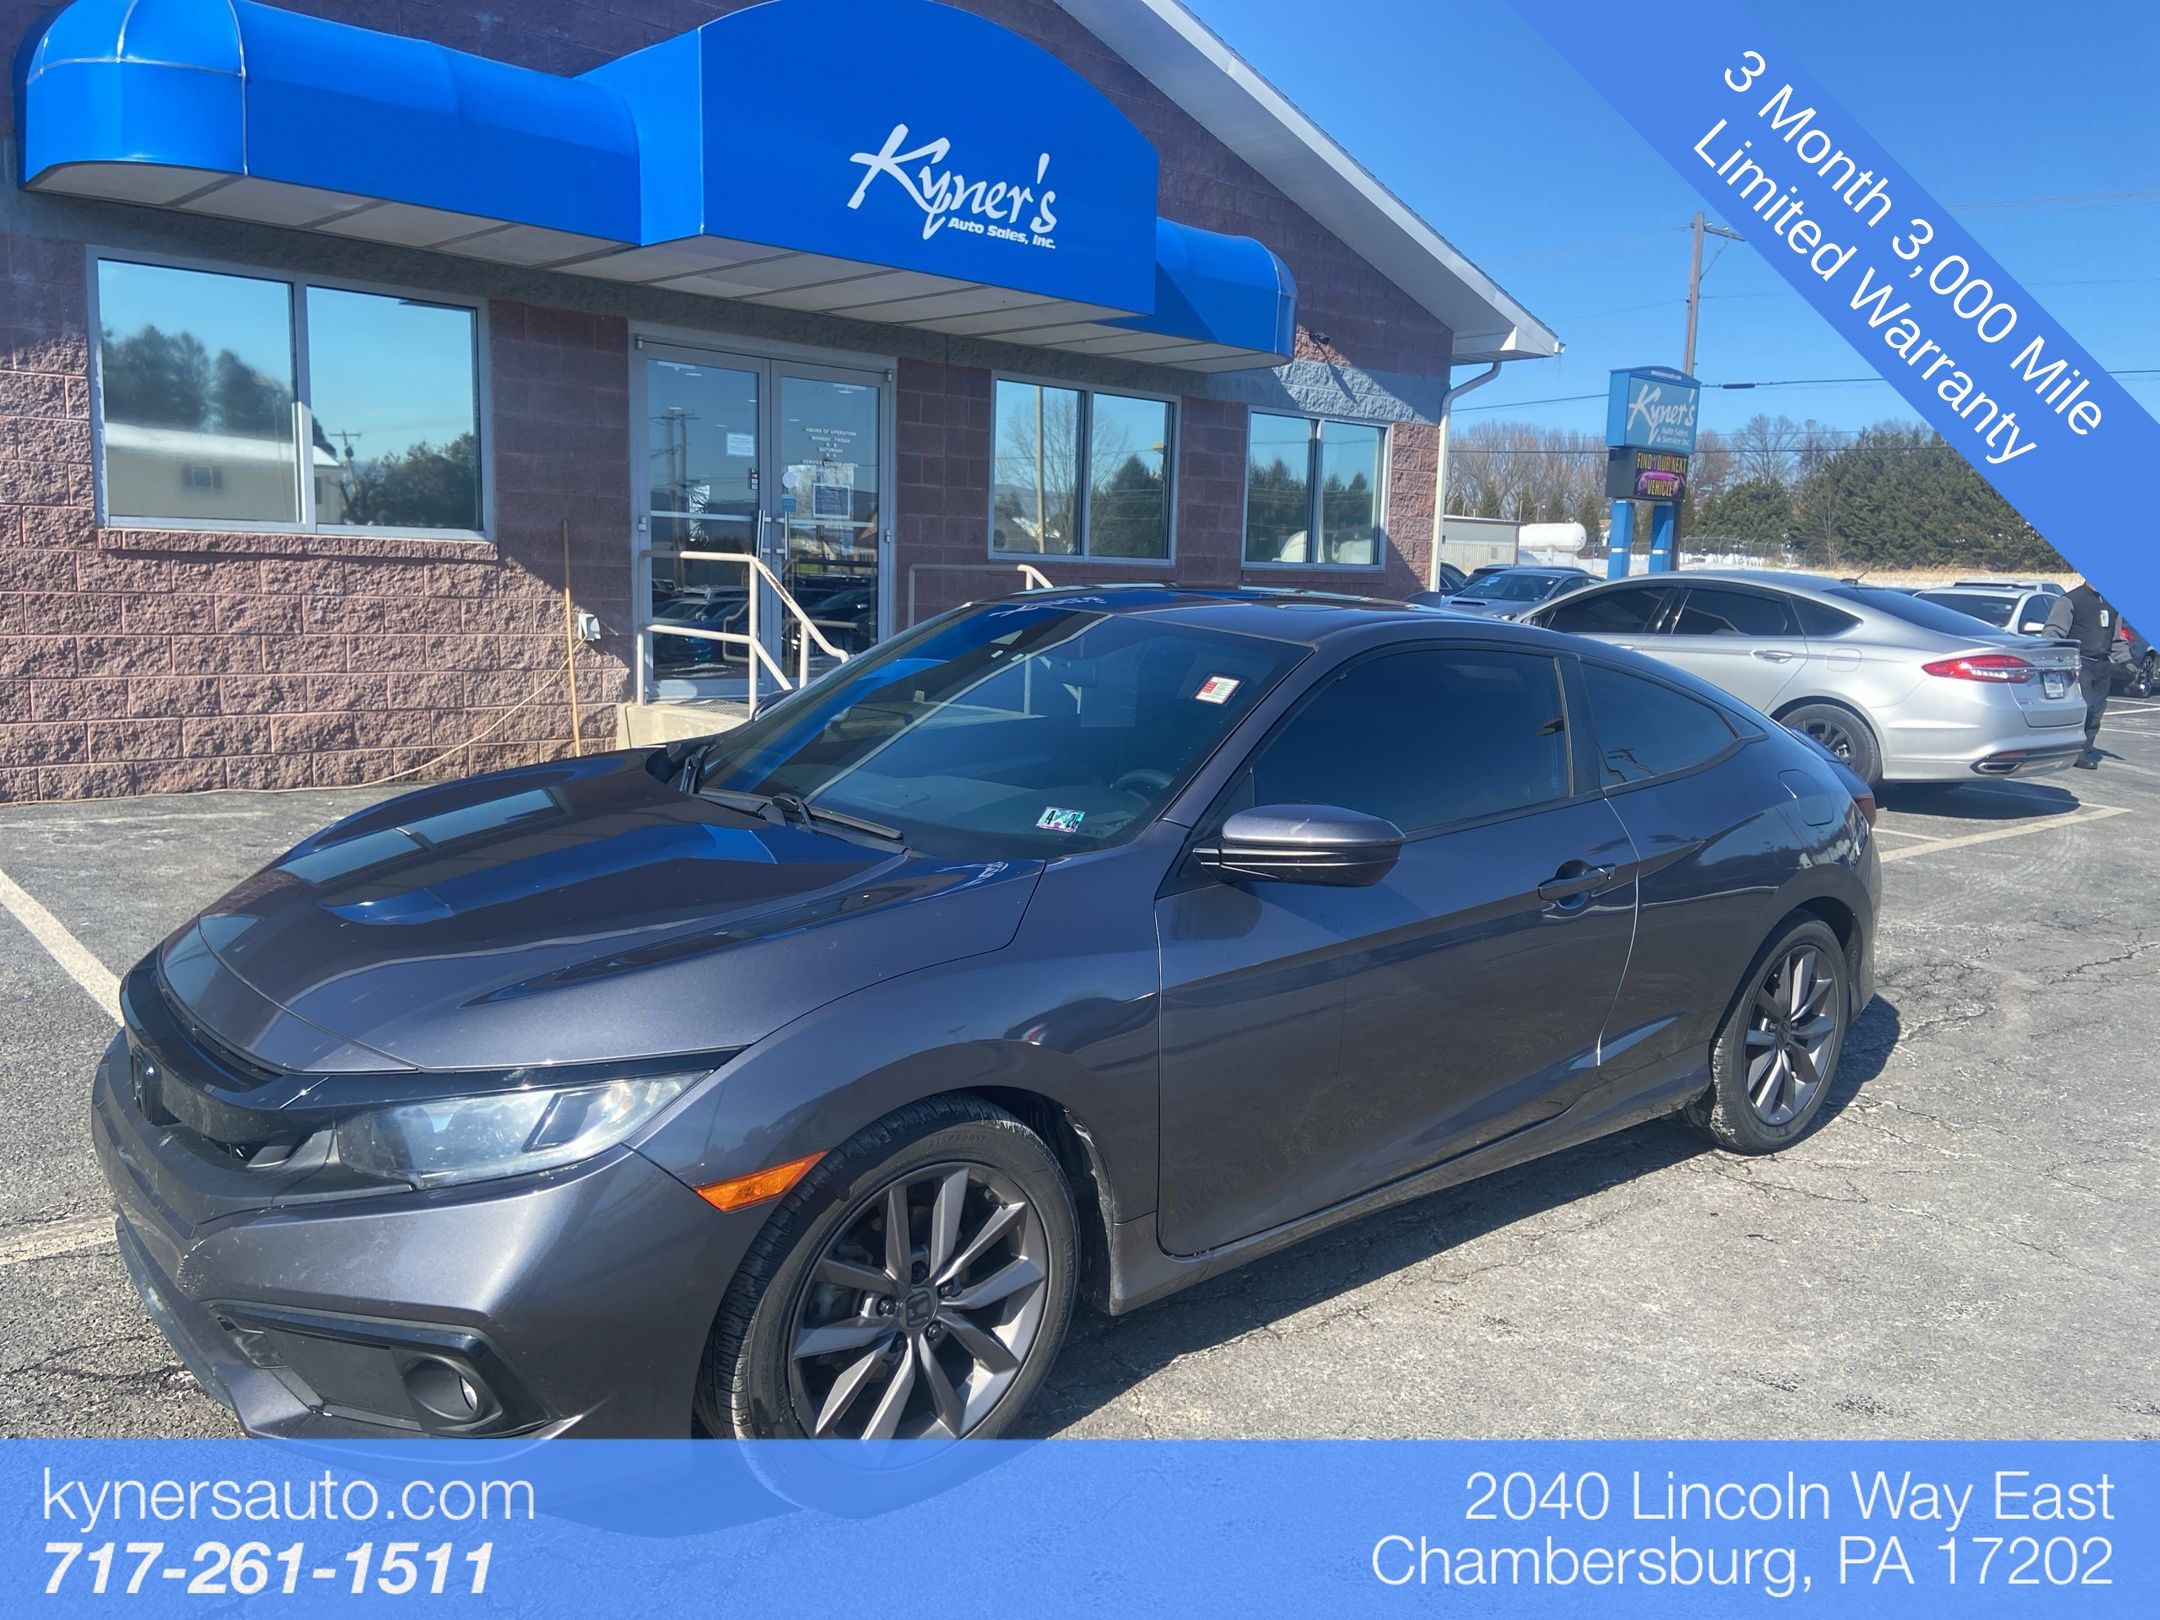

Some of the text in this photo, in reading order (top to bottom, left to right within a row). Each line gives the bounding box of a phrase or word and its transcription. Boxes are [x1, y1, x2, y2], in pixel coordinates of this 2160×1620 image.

[847, 123, 1057, 240] Kyner's
[948, 217, 1056, 250] Auto Sales, Inc.
[1627, 384, 1695, 445] Kyner's
[1637, 452, 1687, 474] FIND YOUR NEXT
[1647, 479, 1673, 497] VEHICLE
